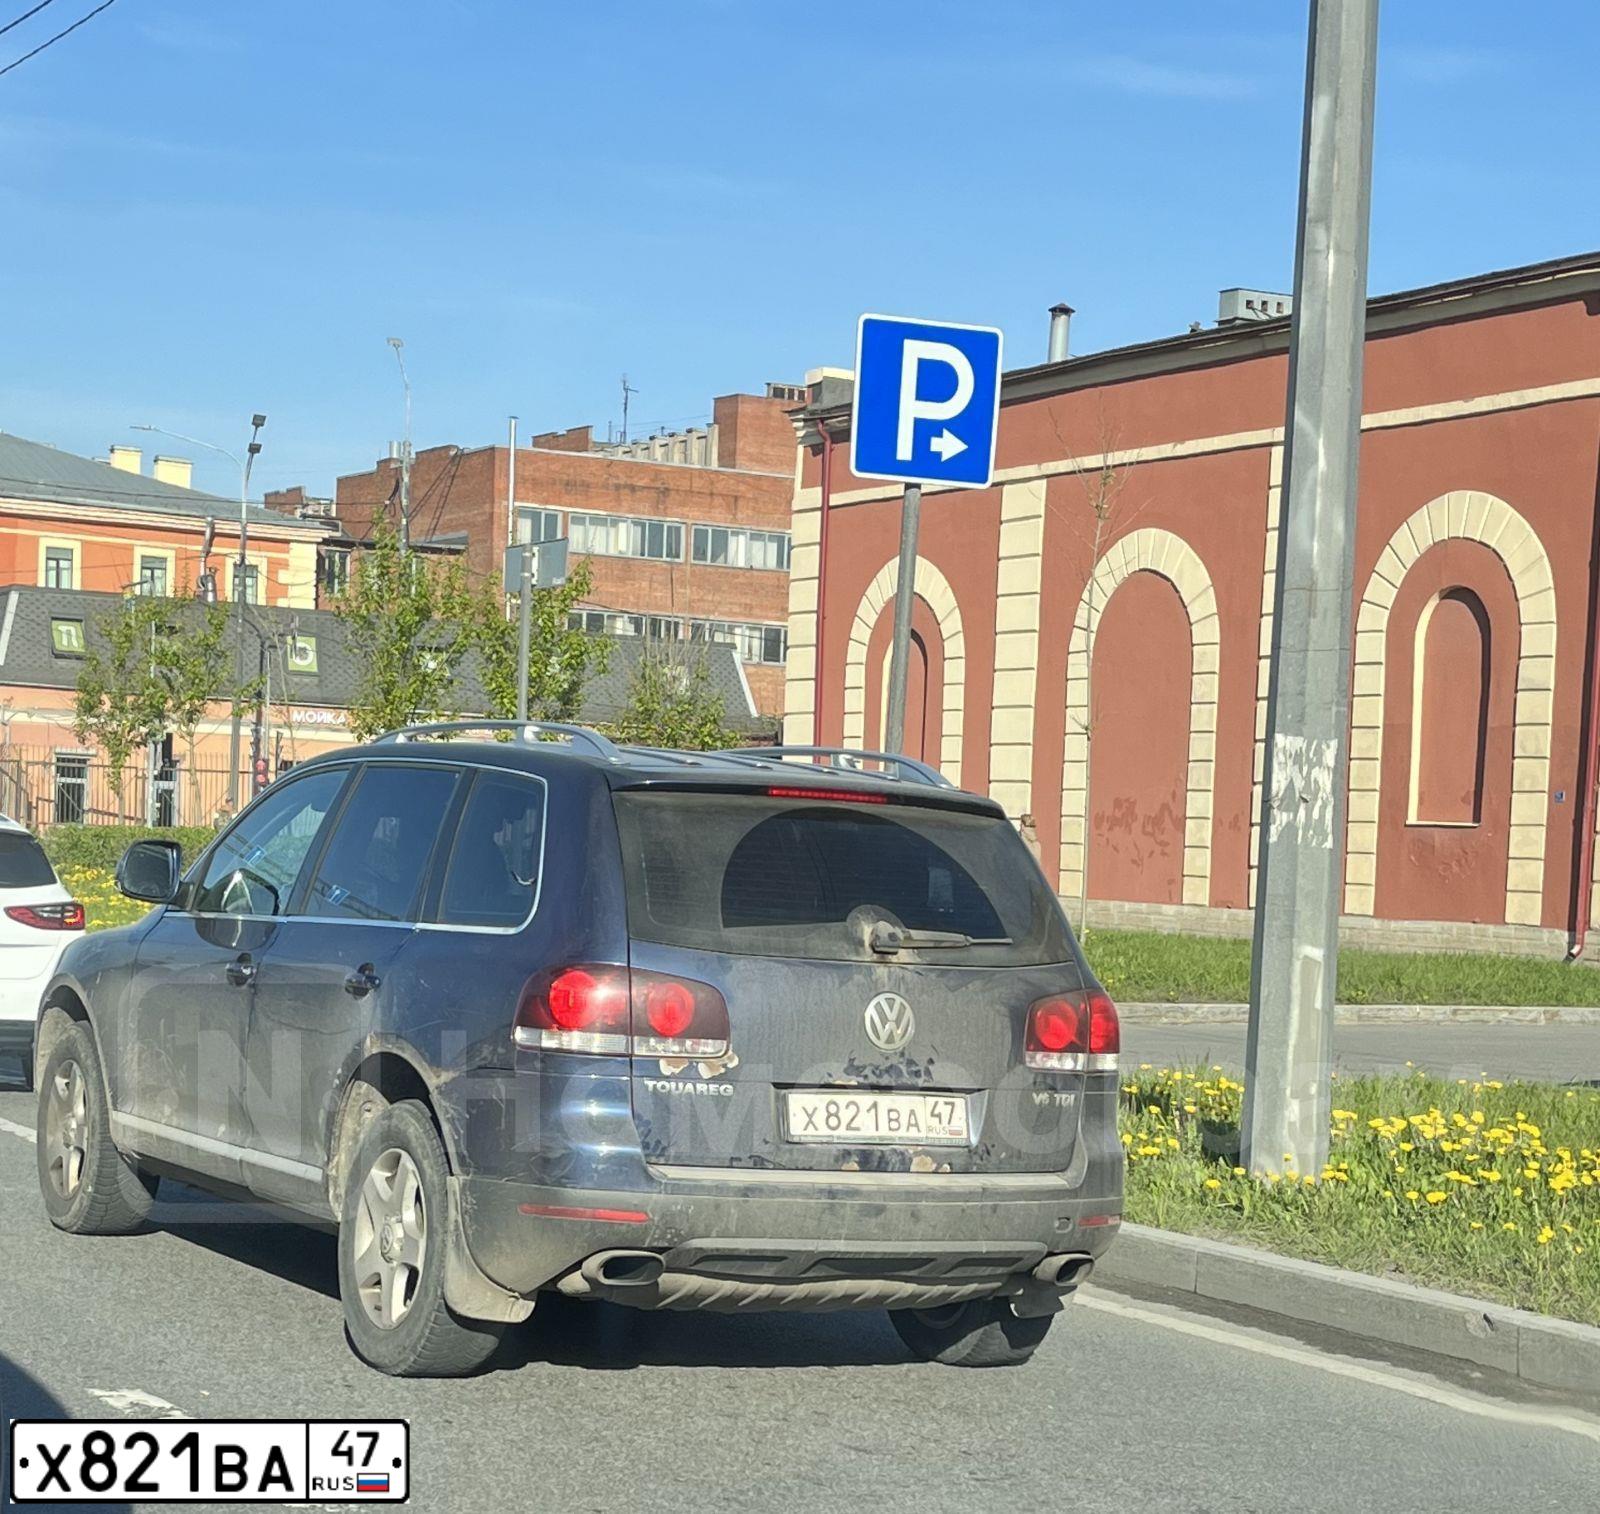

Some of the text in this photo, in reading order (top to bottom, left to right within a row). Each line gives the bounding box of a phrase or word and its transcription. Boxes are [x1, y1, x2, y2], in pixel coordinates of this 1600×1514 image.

[896, 338, 975, 461] P
[643, 1079, 734, 1097] TOUAREG
[1054, 1093, 1076, 1107] TDI
[802, 1100, 956, 1133] Х821ВА 47
[927, 1125, 948, 1136] RUS
